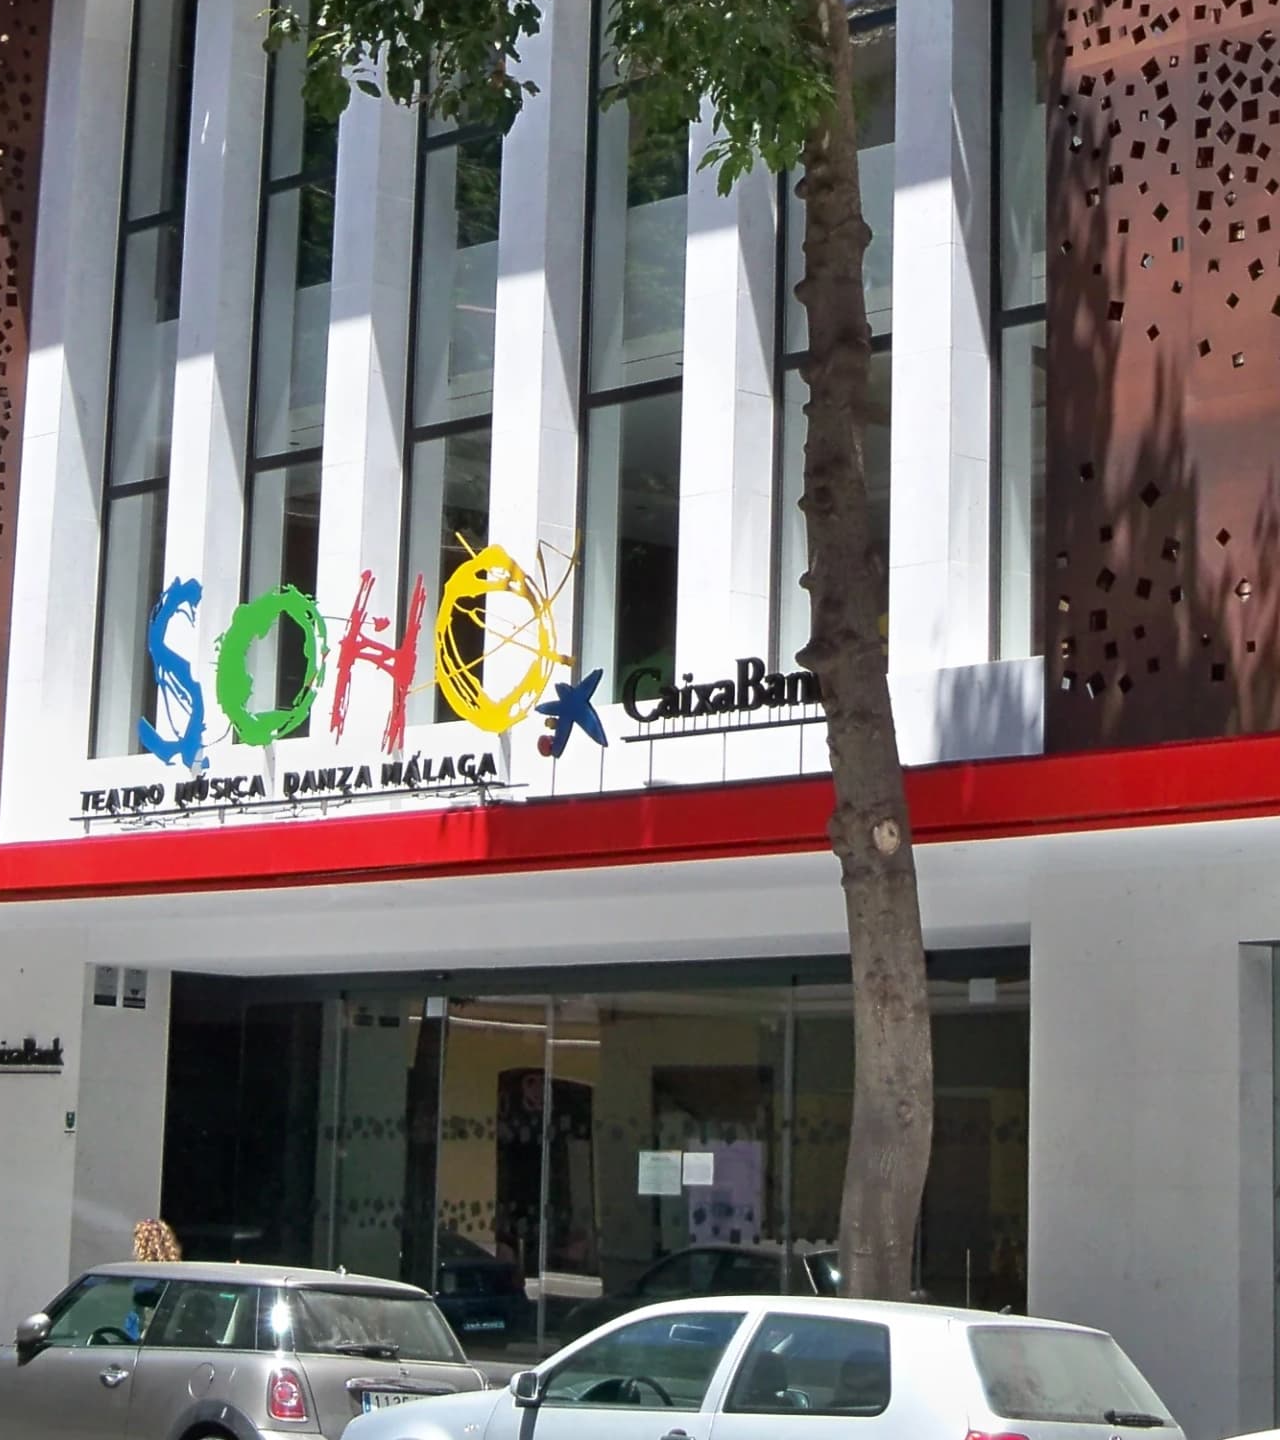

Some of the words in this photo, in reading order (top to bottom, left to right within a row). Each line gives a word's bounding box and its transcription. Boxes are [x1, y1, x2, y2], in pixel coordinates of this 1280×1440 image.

[138, 531, 578, 769] SOHO
[80, 783, 164, 813] TEATRO
[175, 773, 266, 806] MÚSICA
[283, 764, 372, 797] DANZA
[381, 751, 498, 785] MÁLAGA
